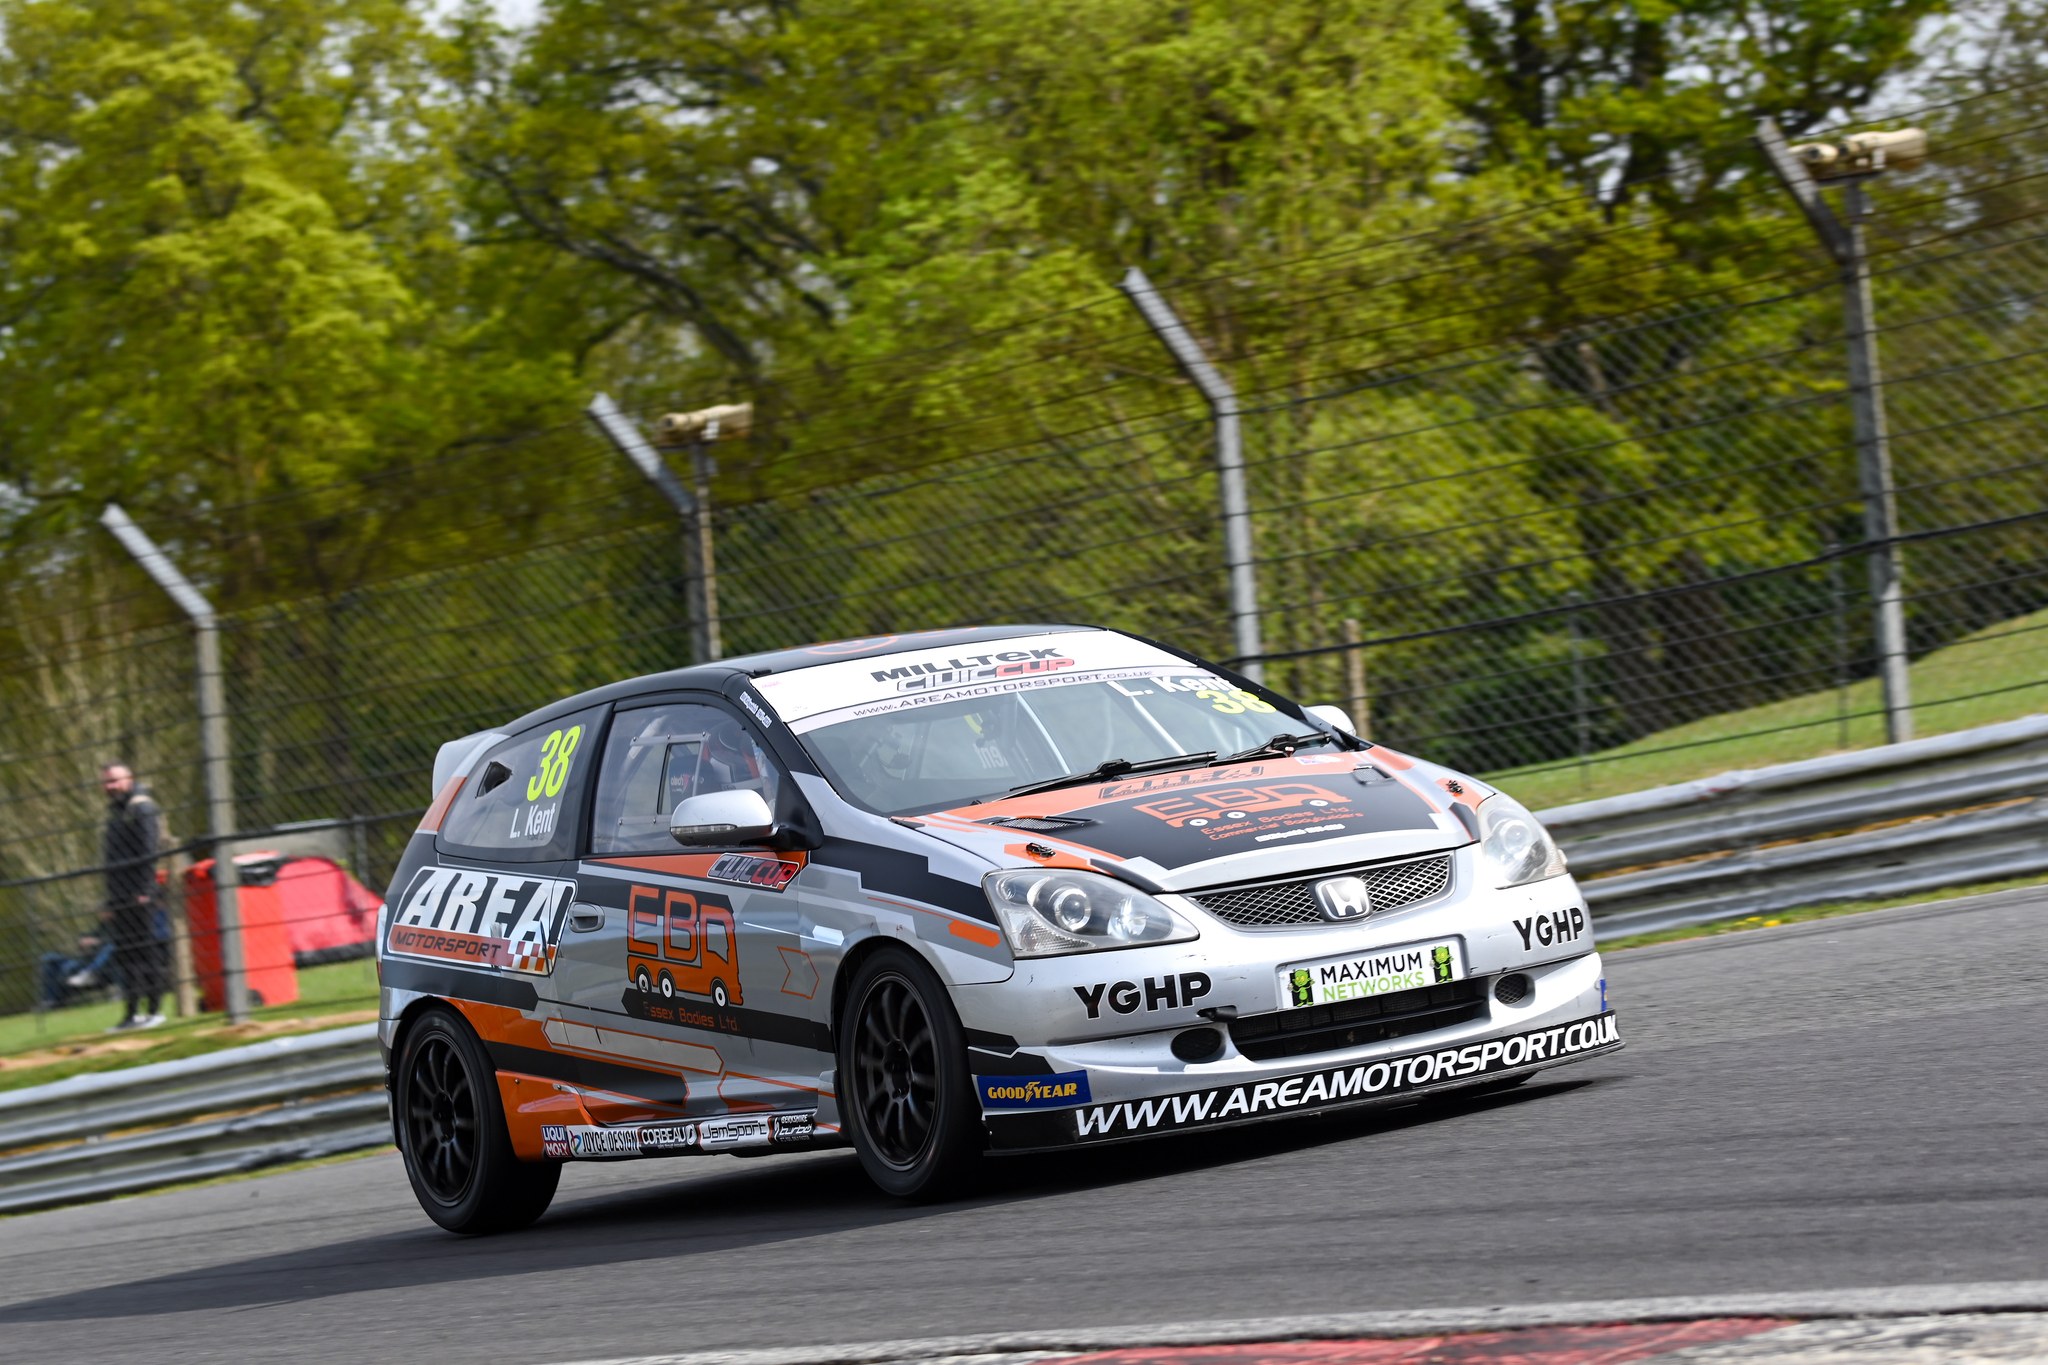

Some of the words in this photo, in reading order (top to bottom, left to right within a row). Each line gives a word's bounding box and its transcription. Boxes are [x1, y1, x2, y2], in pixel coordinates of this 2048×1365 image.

[1106, 680, 1154, 697] L.
[1150, 676, 1242, 693] Kent
[1195, 689, 1277, 714] 38
[527, 725, 581, 801] 38
[509, 808, 521, 839] L.
[524, 802, 556, 836] Kent
[1200, 820, 1253, 835] Essex
[1258, 810, 1315, 823] Bodies
[1209, 822, 1281, 841] Commercial
[398, 867, 566, 943] AREA
[1512, 907, 1585, 952] YGHP
[395, 931, 502, 958] MOTORSPORT
[1320, 951, 1423, 985] MAXIMUM
[1073, 971, 1212, 1020] YGHP
[1323, 971, 1425, 1002] NETWORKS
[679, 1007, 715, 1027] Bodies
[1075, 1014, 1621, 1136] WWW.AREAMOTORSPORT.CO.UK
[987, 1081, 1078, 1102] GOODYEAR
[542, 1126, 565, 1141] LIQUI
[581, 1131, 607, 1153] JOYCE
[607, 1129, 639, 1152] DESIGN
[641, 1126, 687, 1145] CORBEAU
[702, 1121, 767, 1143] JamSport
[545, 1142, 569, 1156] MOLY
